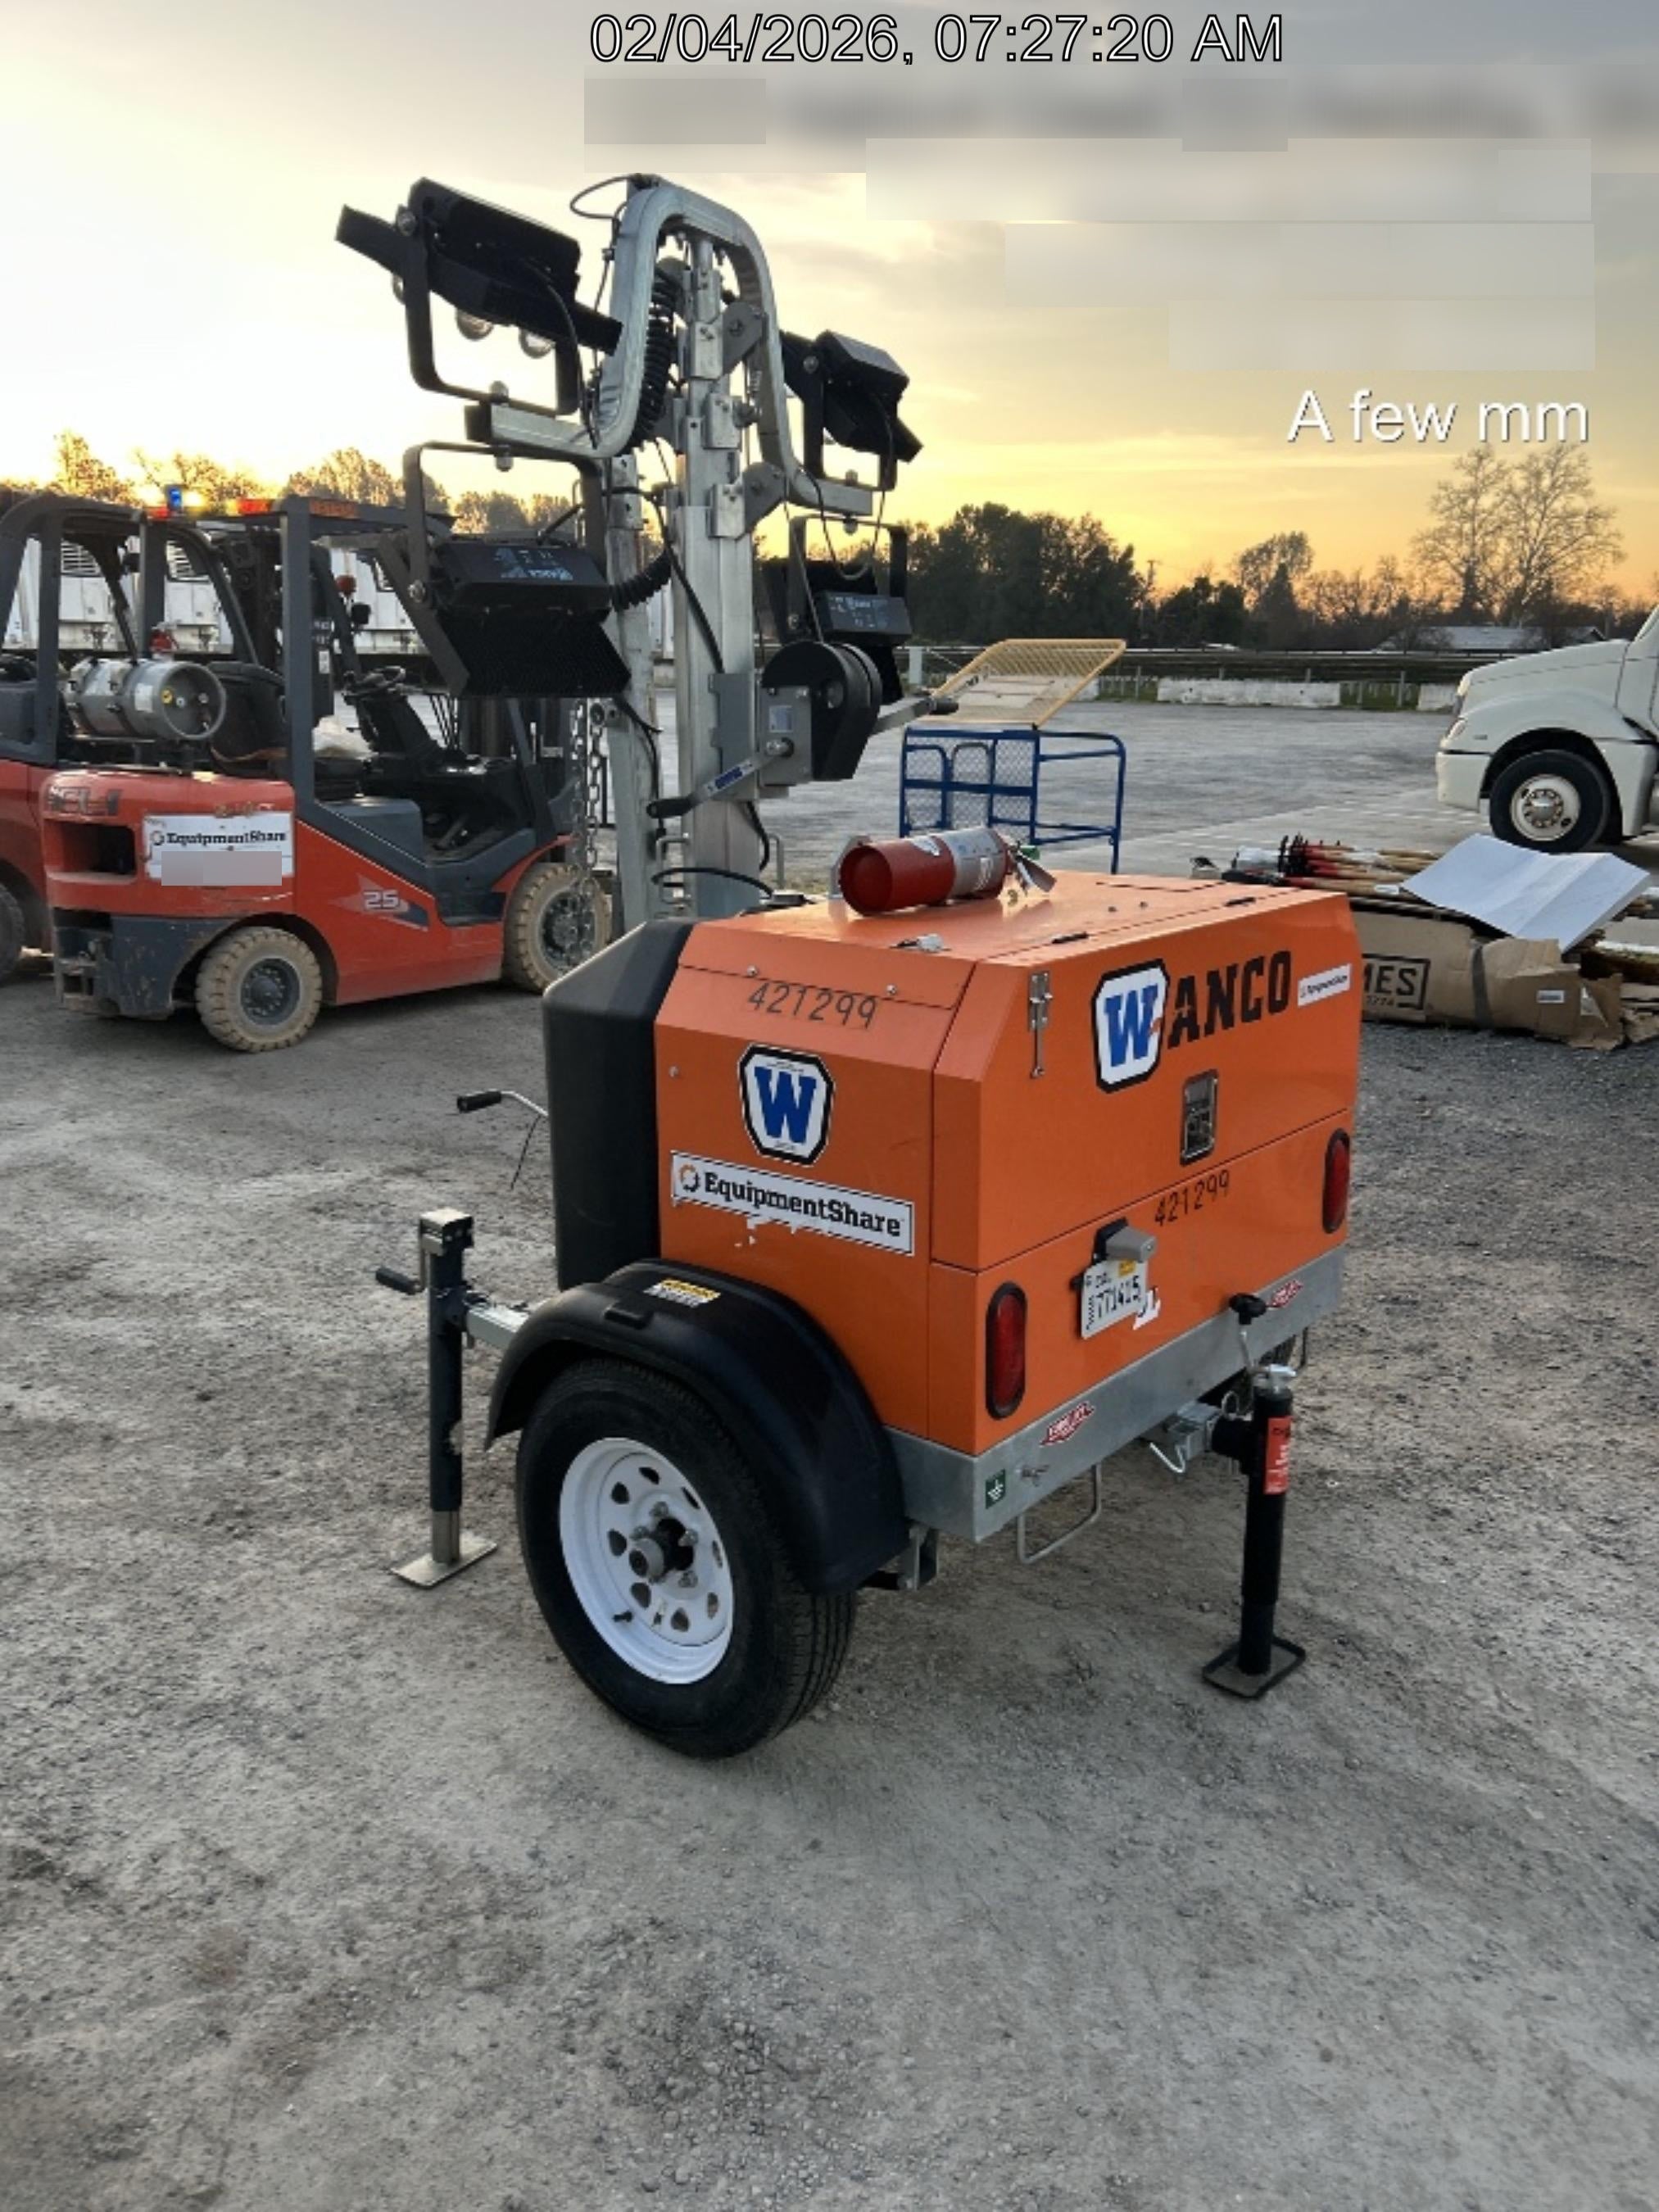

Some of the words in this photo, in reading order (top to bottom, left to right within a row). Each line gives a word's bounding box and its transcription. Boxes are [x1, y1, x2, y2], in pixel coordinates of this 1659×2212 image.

[363, 889, 400, 909] 25
[748, 983, 877, 1030] 421299
[1104, 950, 1292, 1067] WANCO
[755, 1066, 817, 1144] W
[704, 1172, 901, 1237] EquipmentShare
[1155, 1169, 1229, 1227] 421299
